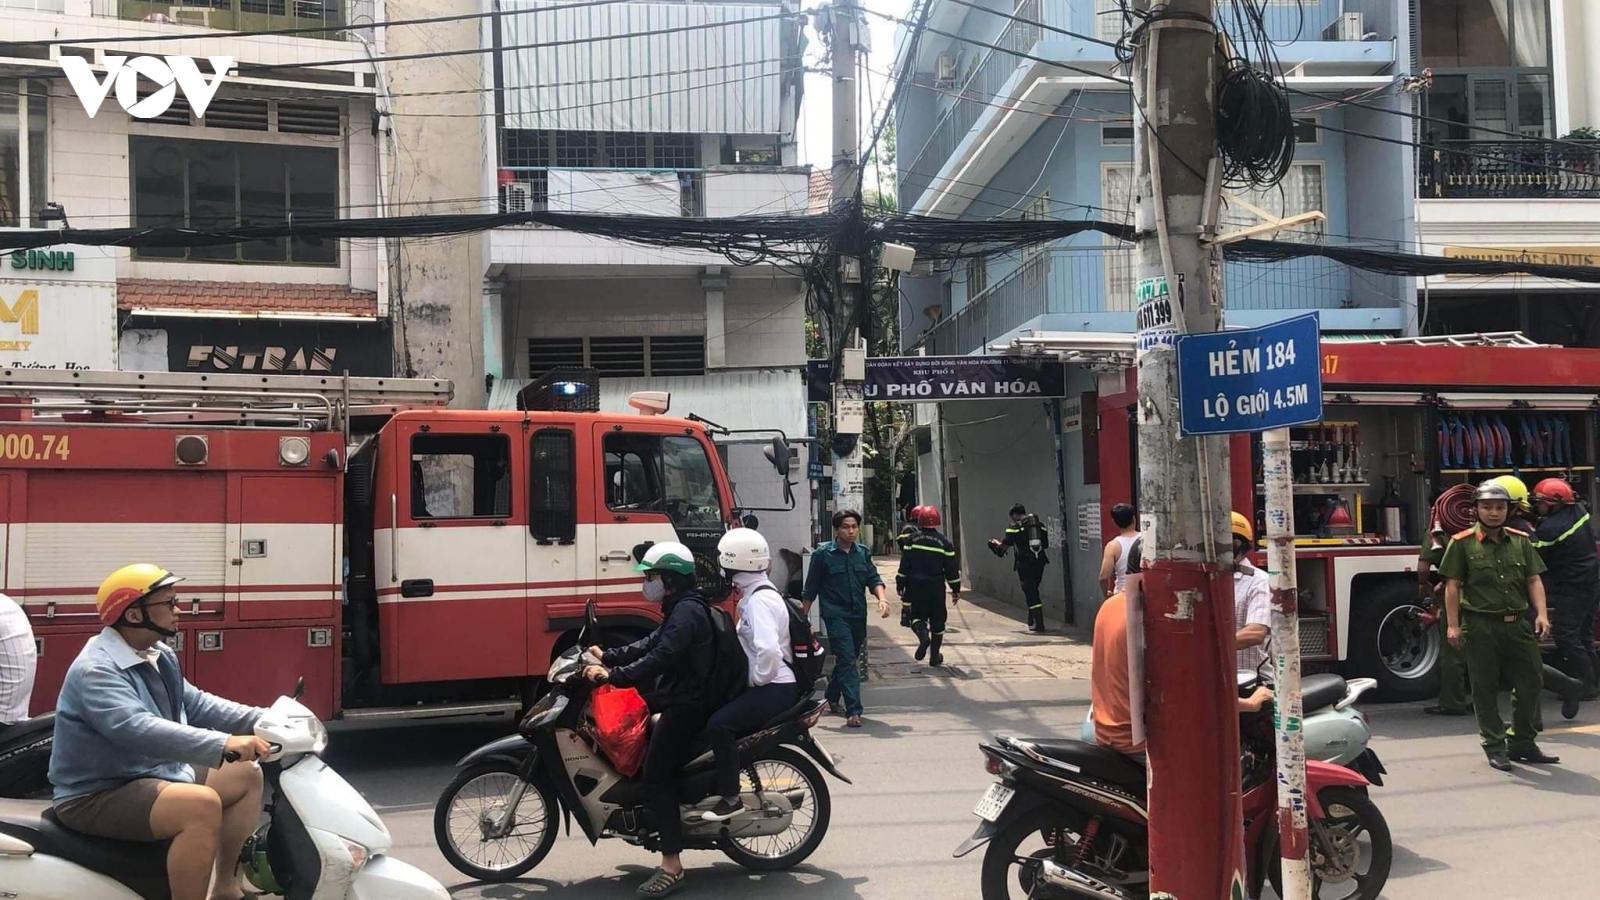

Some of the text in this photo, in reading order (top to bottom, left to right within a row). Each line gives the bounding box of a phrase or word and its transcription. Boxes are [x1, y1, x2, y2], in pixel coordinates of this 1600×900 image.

[11, 249, 75, 272] SINH
[1208, 339, 1296, 377] HẺM 184
[931, 367, 949, 375] PHỐ
[886, 378, 935, 397] PHỐ
[939, 379, 986, 395] VĂN
[994, 377, 1042, 394] HÓA
[1203, 383, 1308, 422] LỘ GIỚI 4.5M
